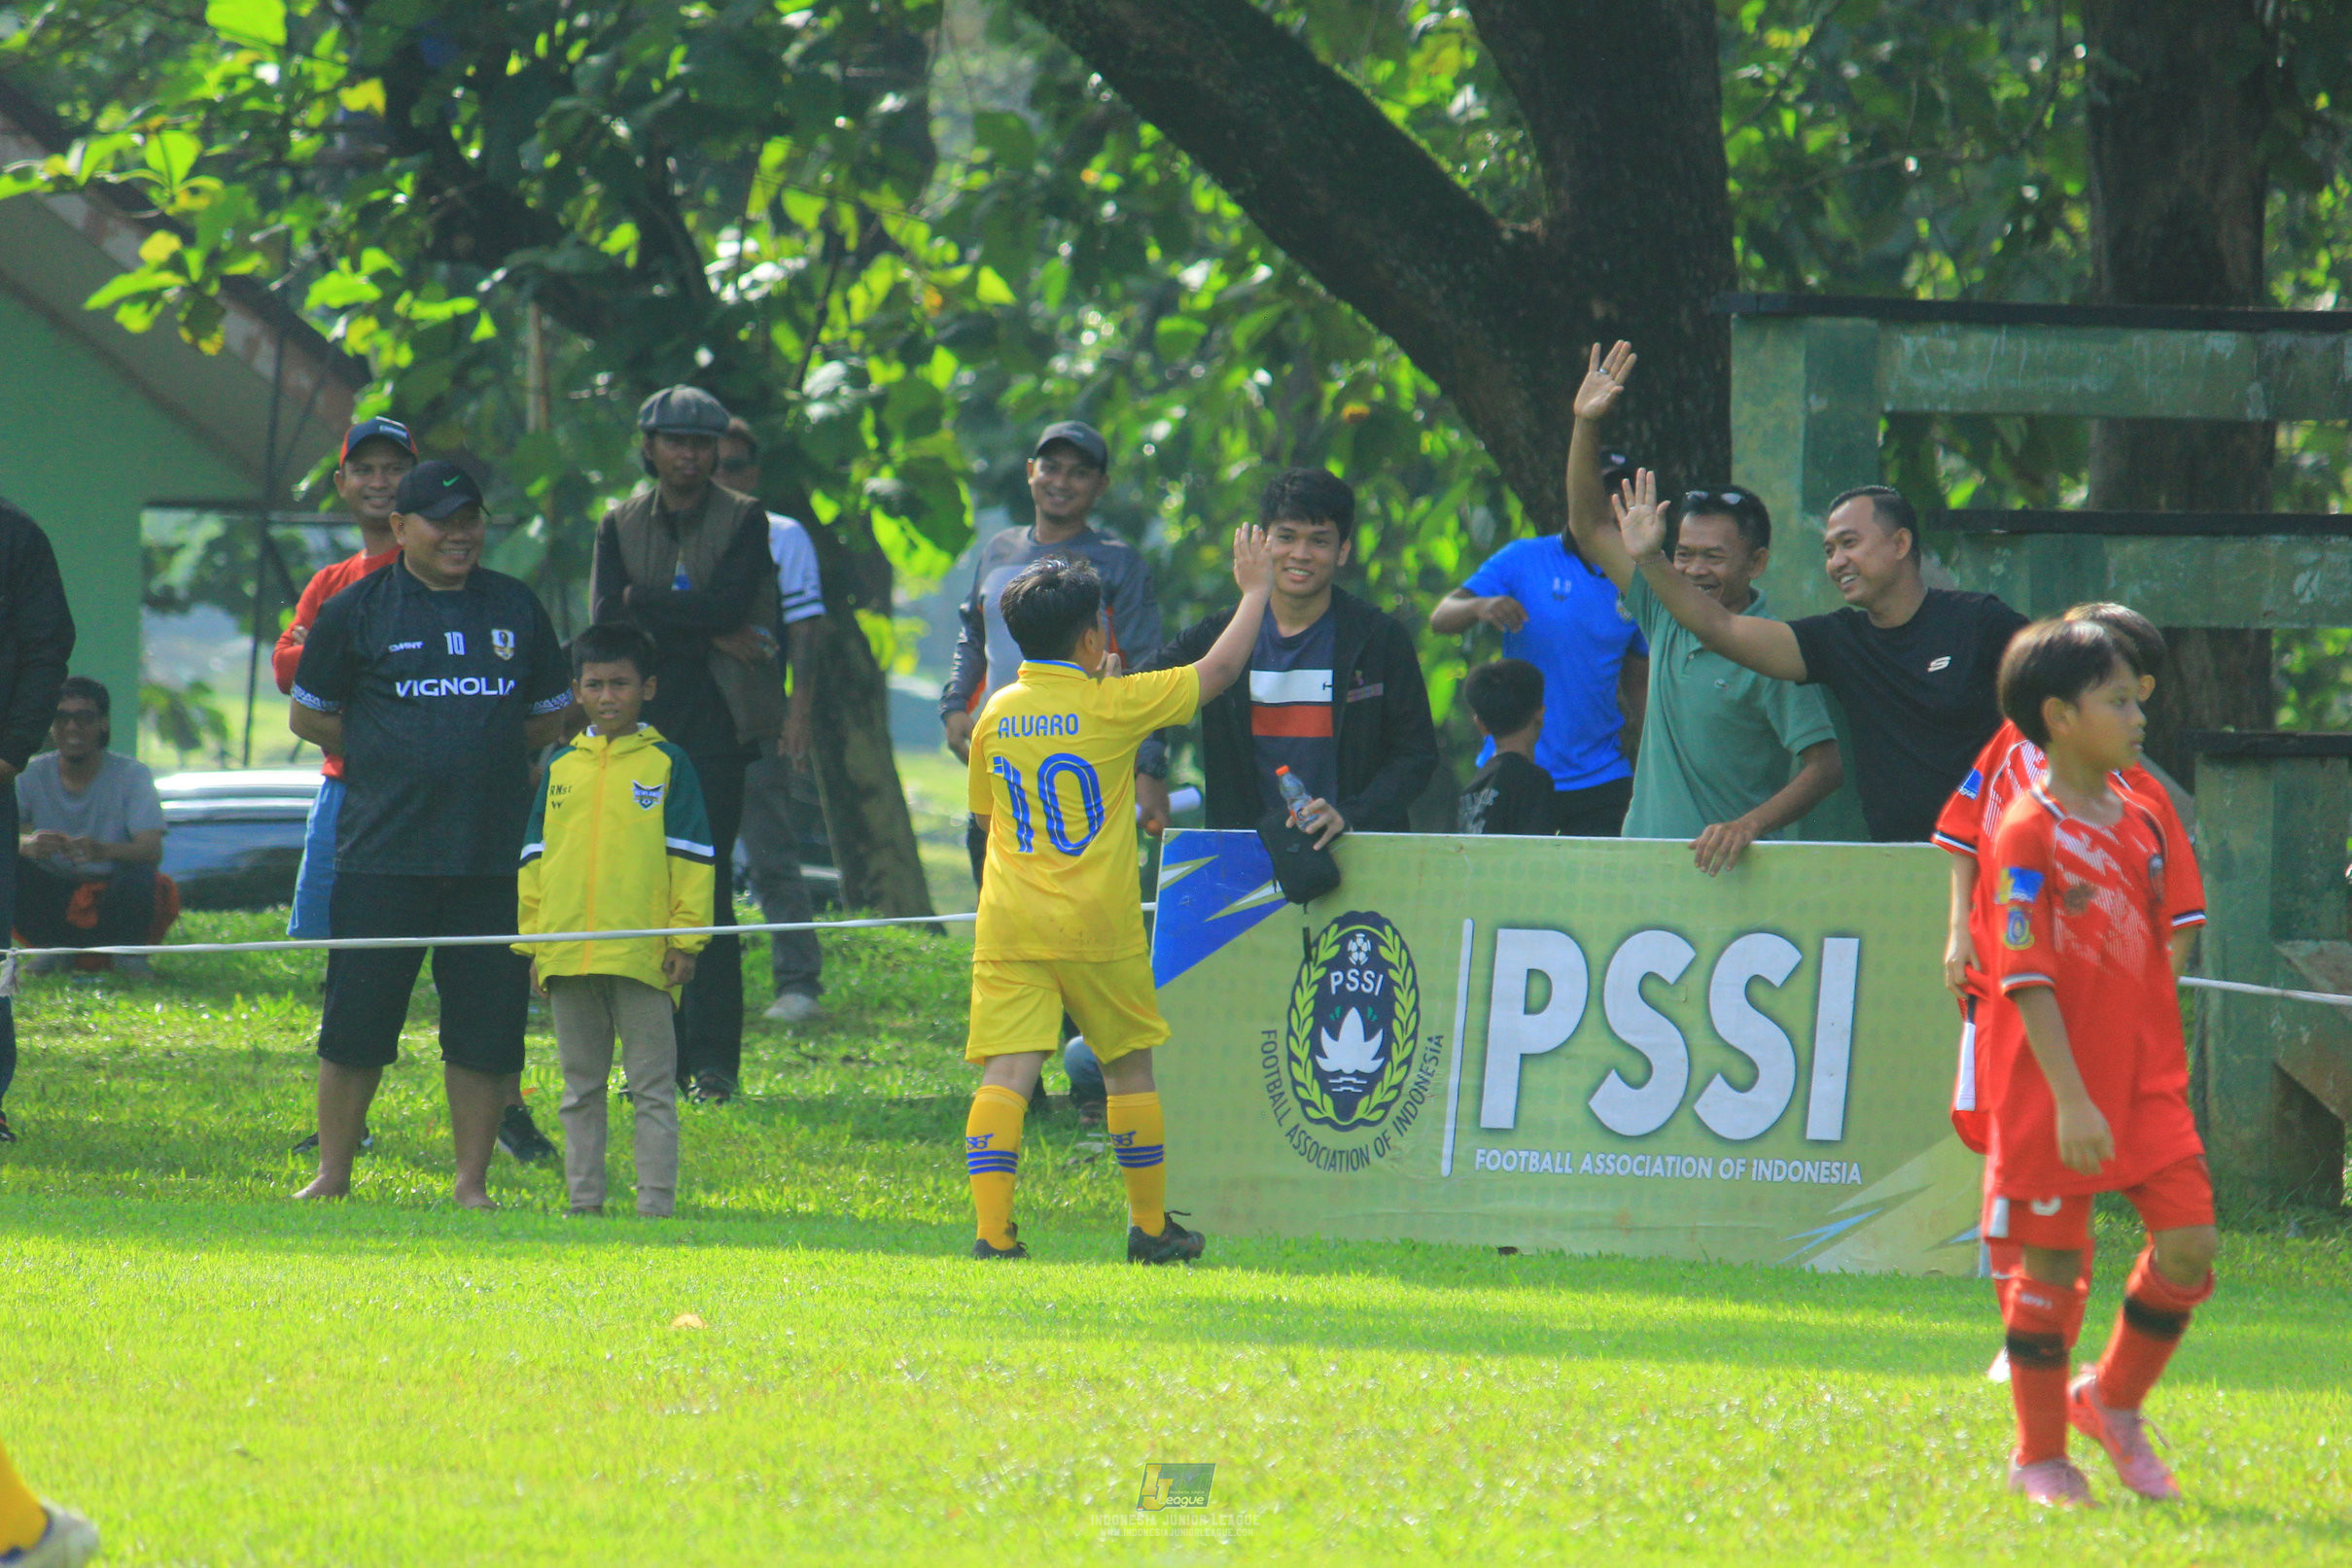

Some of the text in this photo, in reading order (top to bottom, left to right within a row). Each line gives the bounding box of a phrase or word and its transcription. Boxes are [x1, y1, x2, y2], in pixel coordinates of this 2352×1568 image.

[443, 631, 466, 656] 10
[998, 713, 1080, 740] ALVARO
[993, 752, 1106, 857] 10
[1330, 968, 1384, 996] PSSI
[1480, 928, 1860, 1141] PSSI
[1260, 1028, 1445, 1173] FOOTBALL ASSOCIATION OF INDONESIA
[1474, 1148, 1863, 1185] FOOTBALL ASSOCIATION OF INDONESIA
